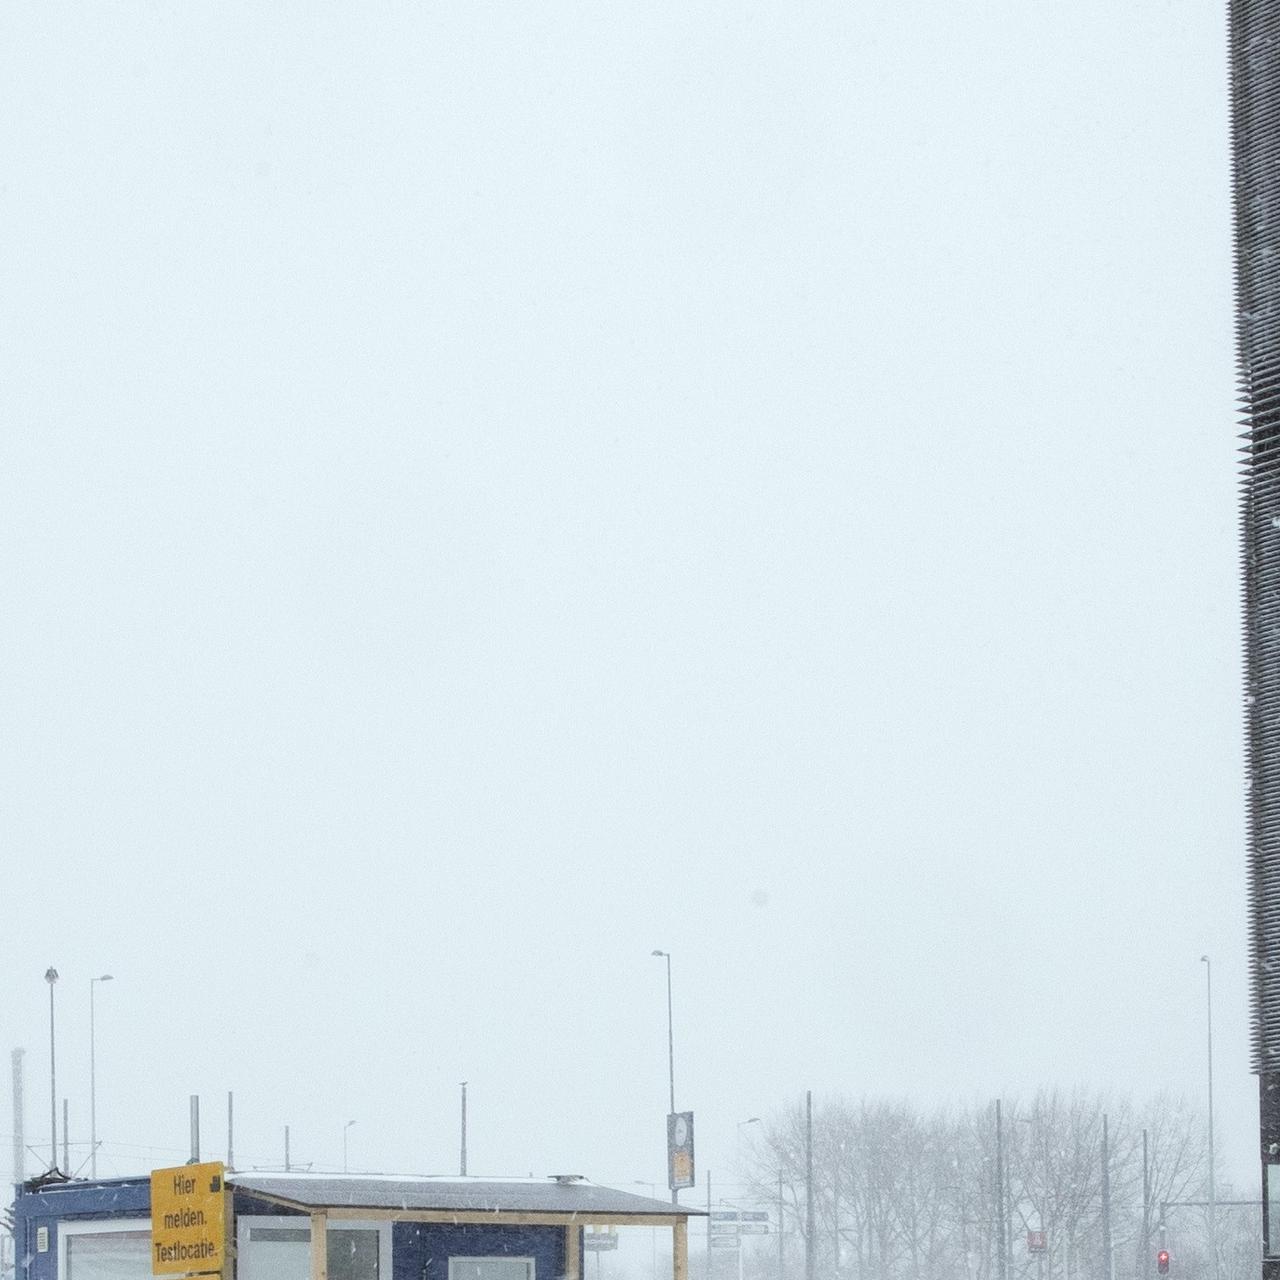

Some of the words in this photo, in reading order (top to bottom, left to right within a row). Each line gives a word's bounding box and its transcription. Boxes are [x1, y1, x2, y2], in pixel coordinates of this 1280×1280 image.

[173, 1174, 196, 1196] Hier
[164, 1210, 208, 1230] melden.
[154, 1239, 219, 1264] Testlocatie.
